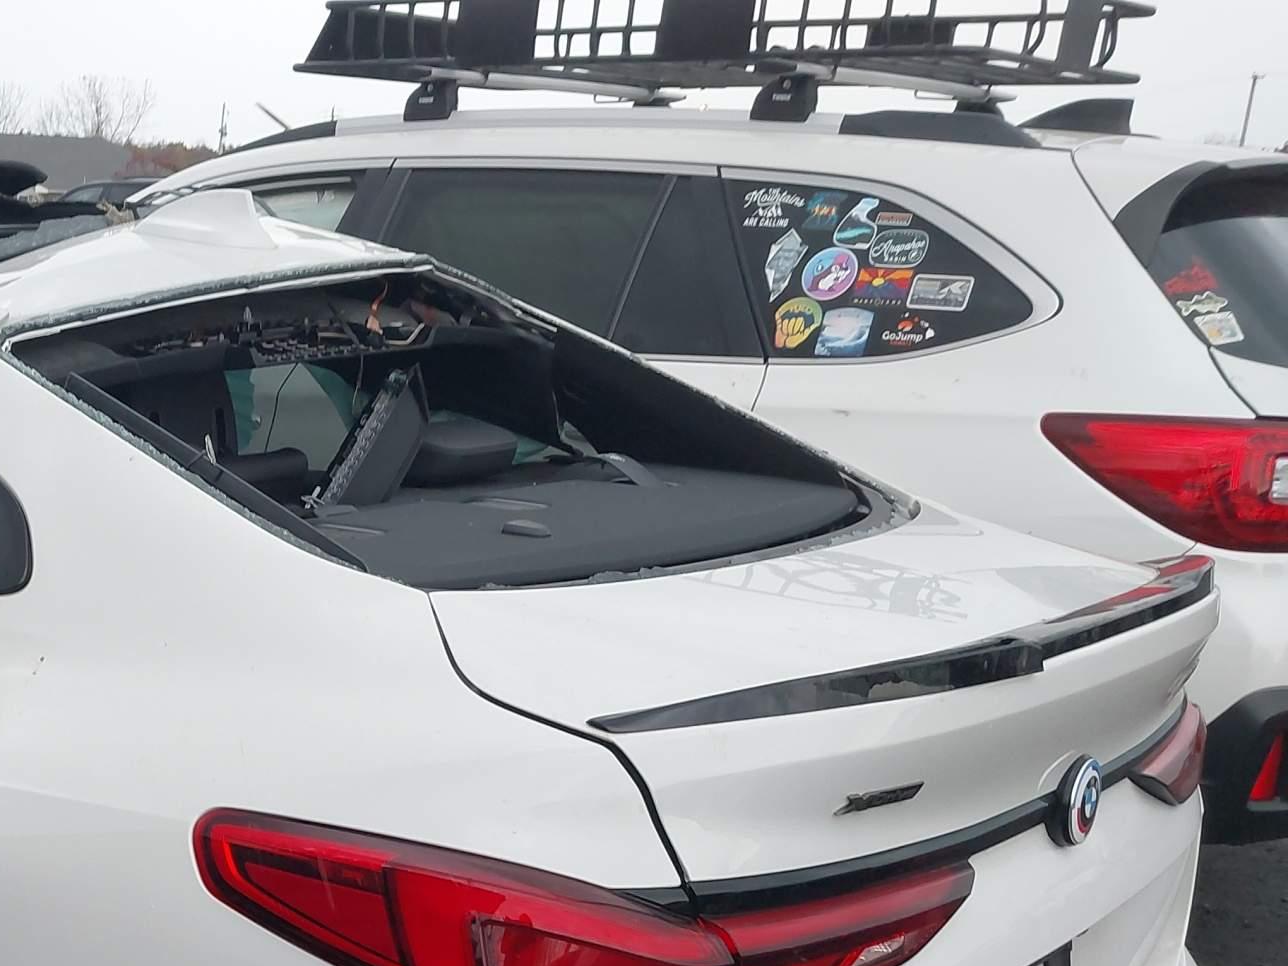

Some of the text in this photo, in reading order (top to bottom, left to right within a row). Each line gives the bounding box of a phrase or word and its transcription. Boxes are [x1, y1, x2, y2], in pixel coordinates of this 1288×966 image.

[743, 188, 805, 208] Mountains
[743, 217, 789, 228] ARE CALLING
[881, 330, 923, 344] GoJump
